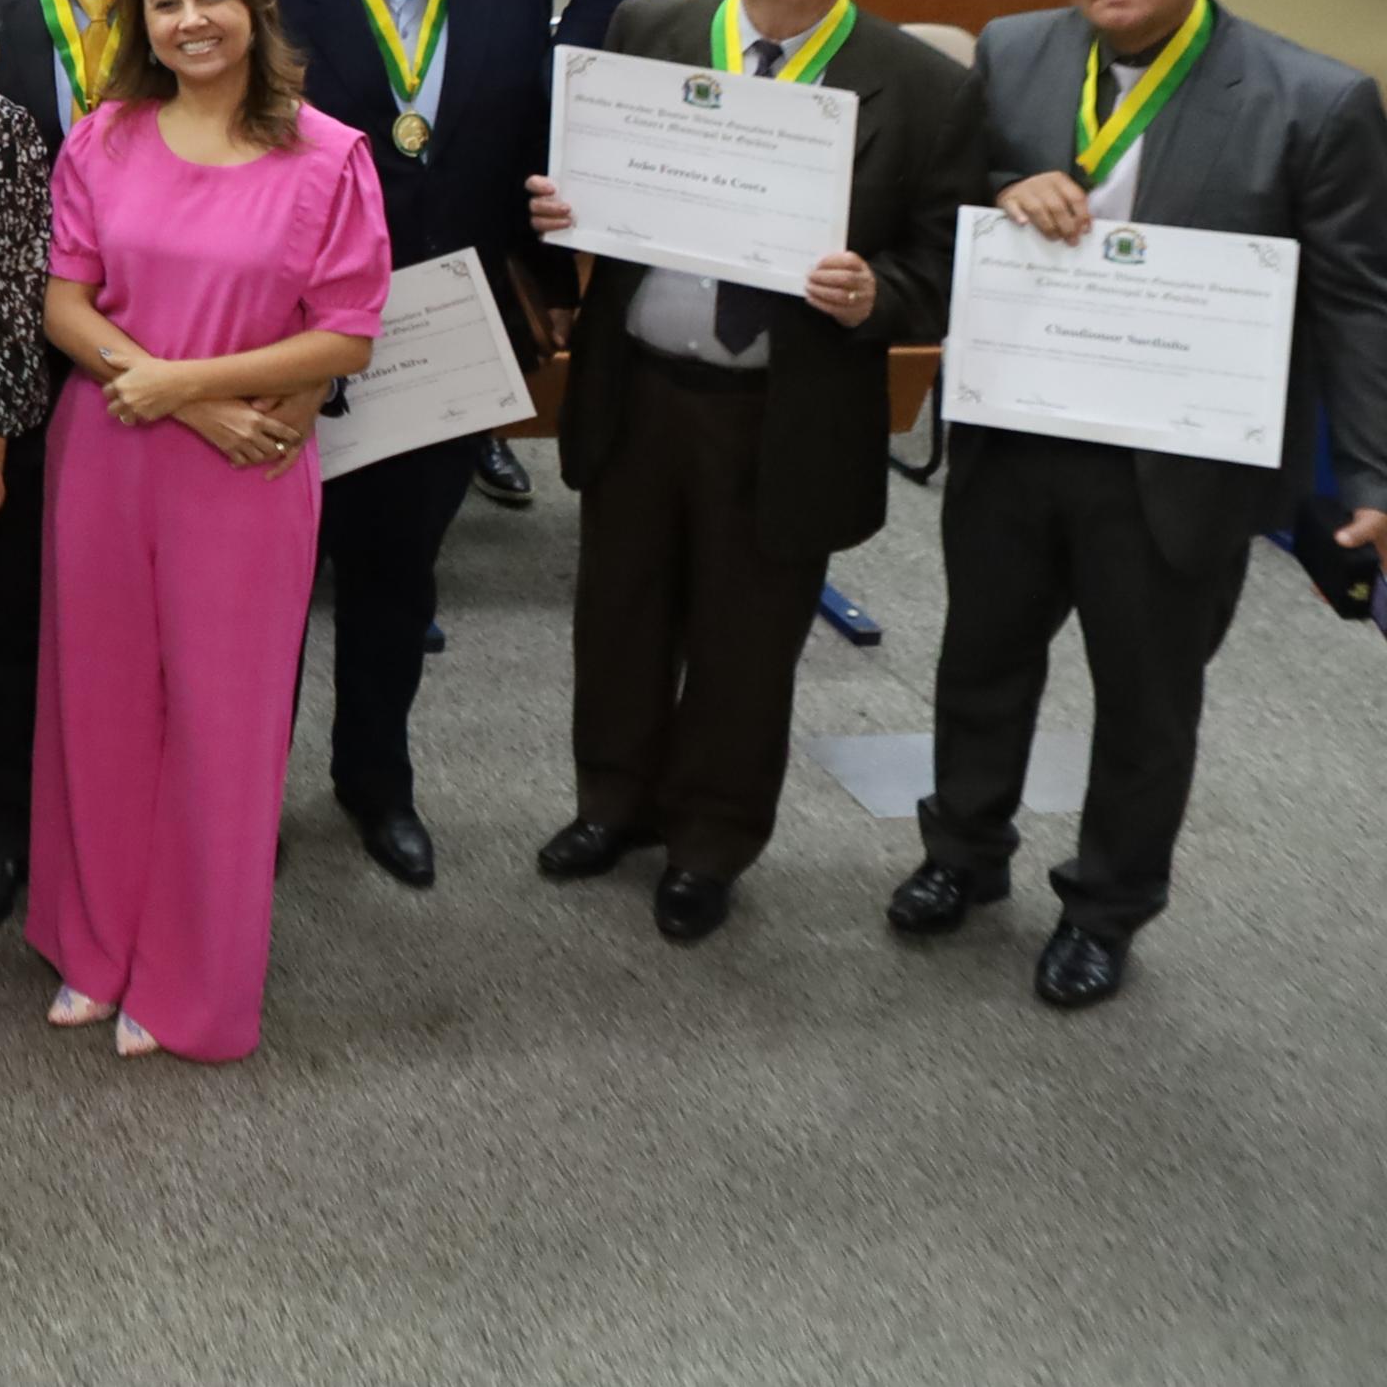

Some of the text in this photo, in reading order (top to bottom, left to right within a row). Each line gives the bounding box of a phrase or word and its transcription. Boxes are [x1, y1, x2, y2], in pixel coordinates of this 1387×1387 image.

[659, 164, 708, 182] Ferreira
[712, 174, 727, 186] da
[730, 177, 767, 193] Costa
[399, 358, 428, 371] Silva
